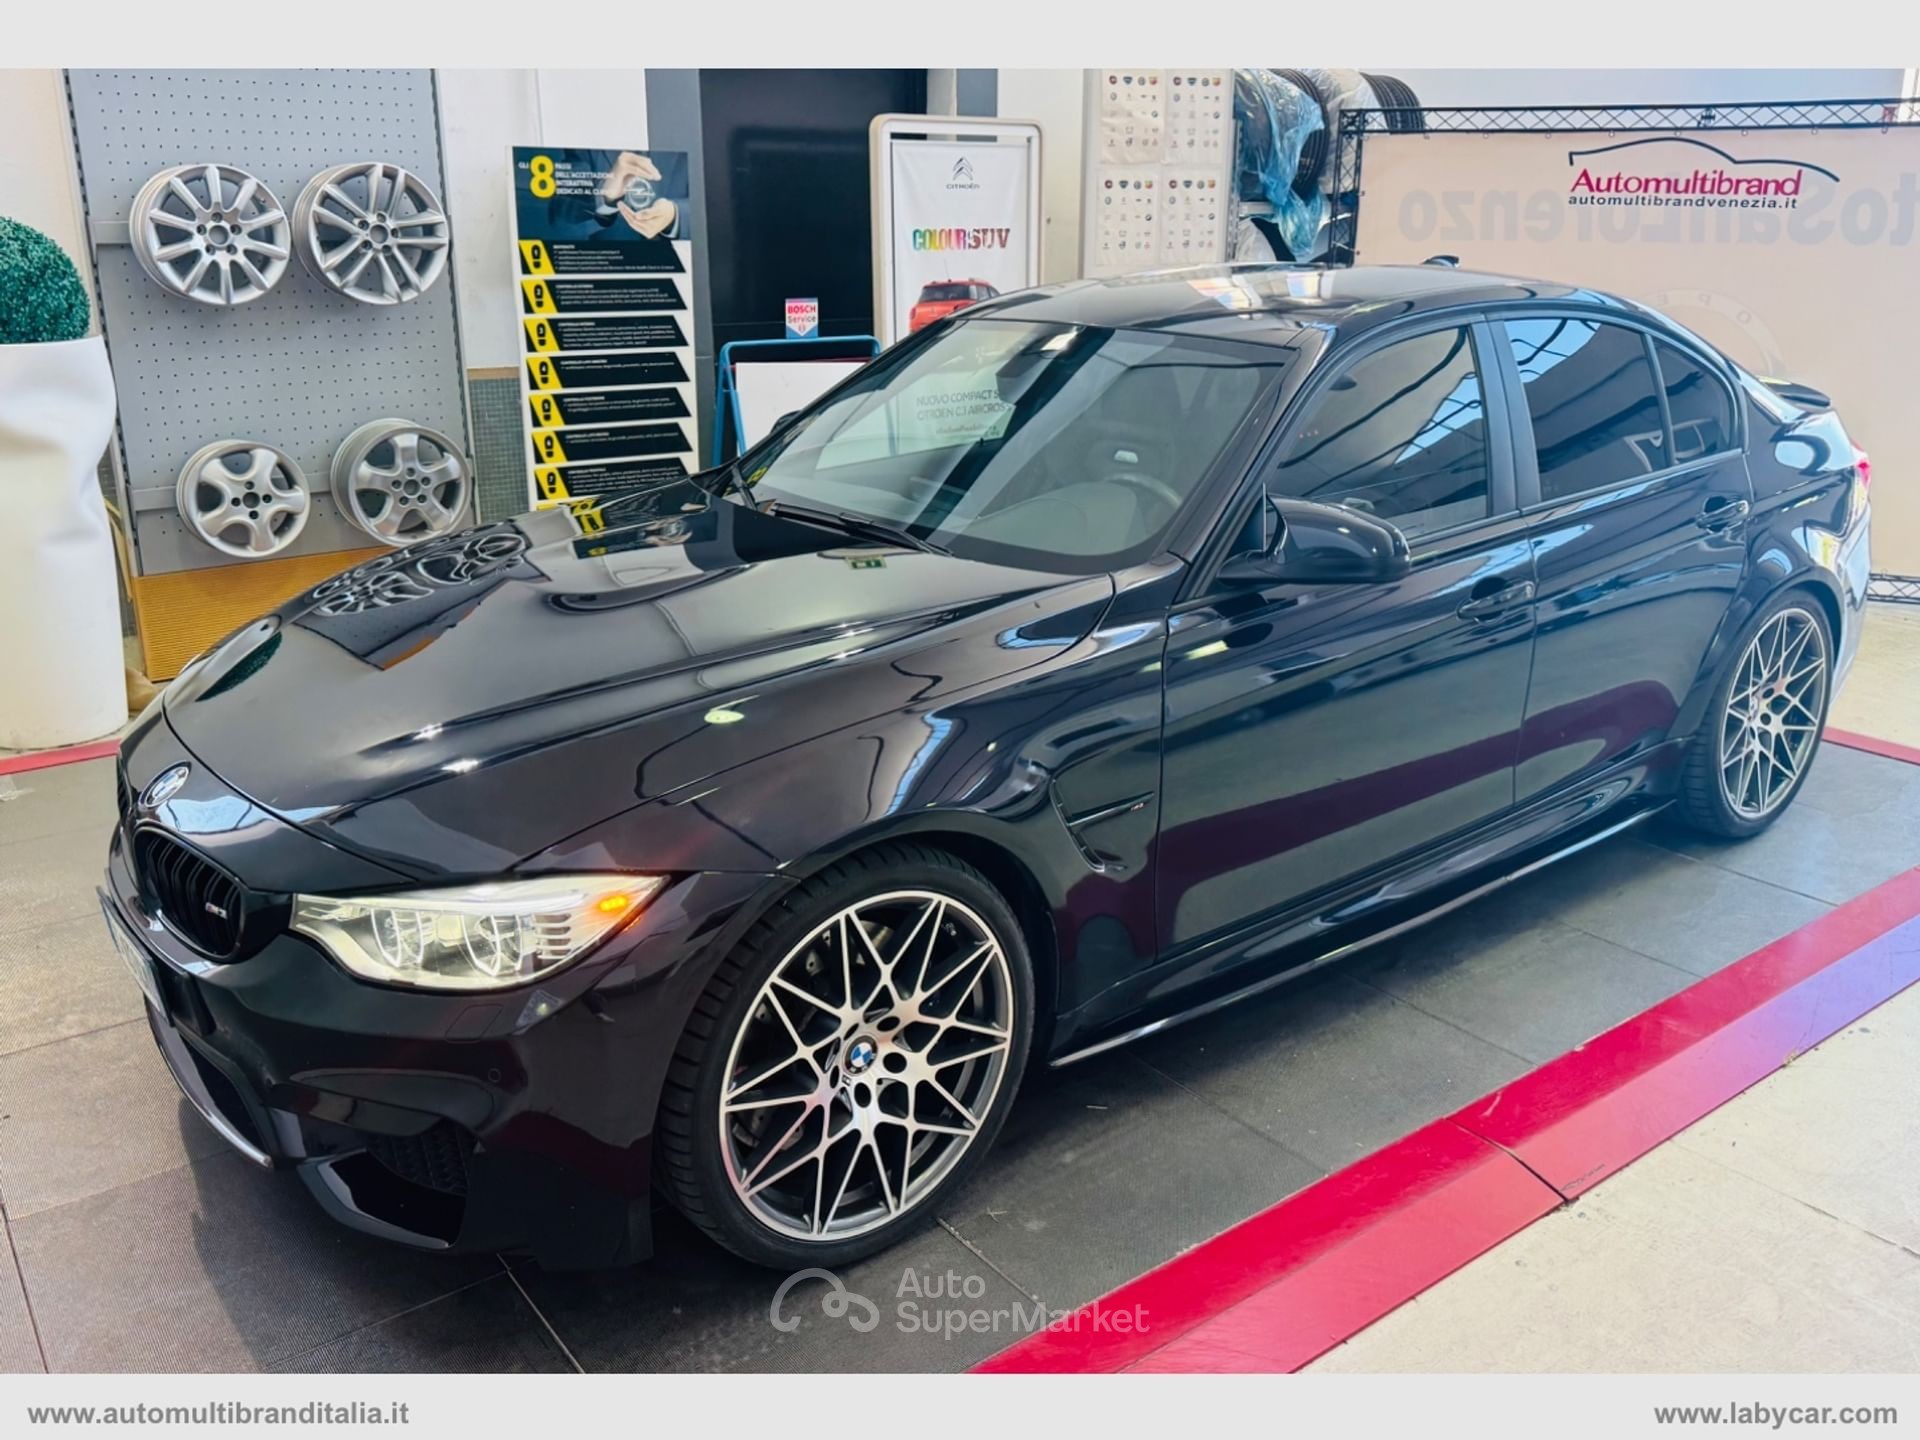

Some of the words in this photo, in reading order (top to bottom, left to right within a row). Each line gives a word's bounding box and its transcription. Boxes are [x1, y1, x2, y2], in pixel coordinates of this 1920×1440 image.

[530, 155, 556, 199] 8
[1570, 168, 1803, 196] Automultibrand
[1568, 195, 1798, 209] automultibrandvenezia.it
[787, 304, 816, 314] BOSCH
[787, 316, 816, 324] Service
[951, 389, 993, 403] COMPACT
